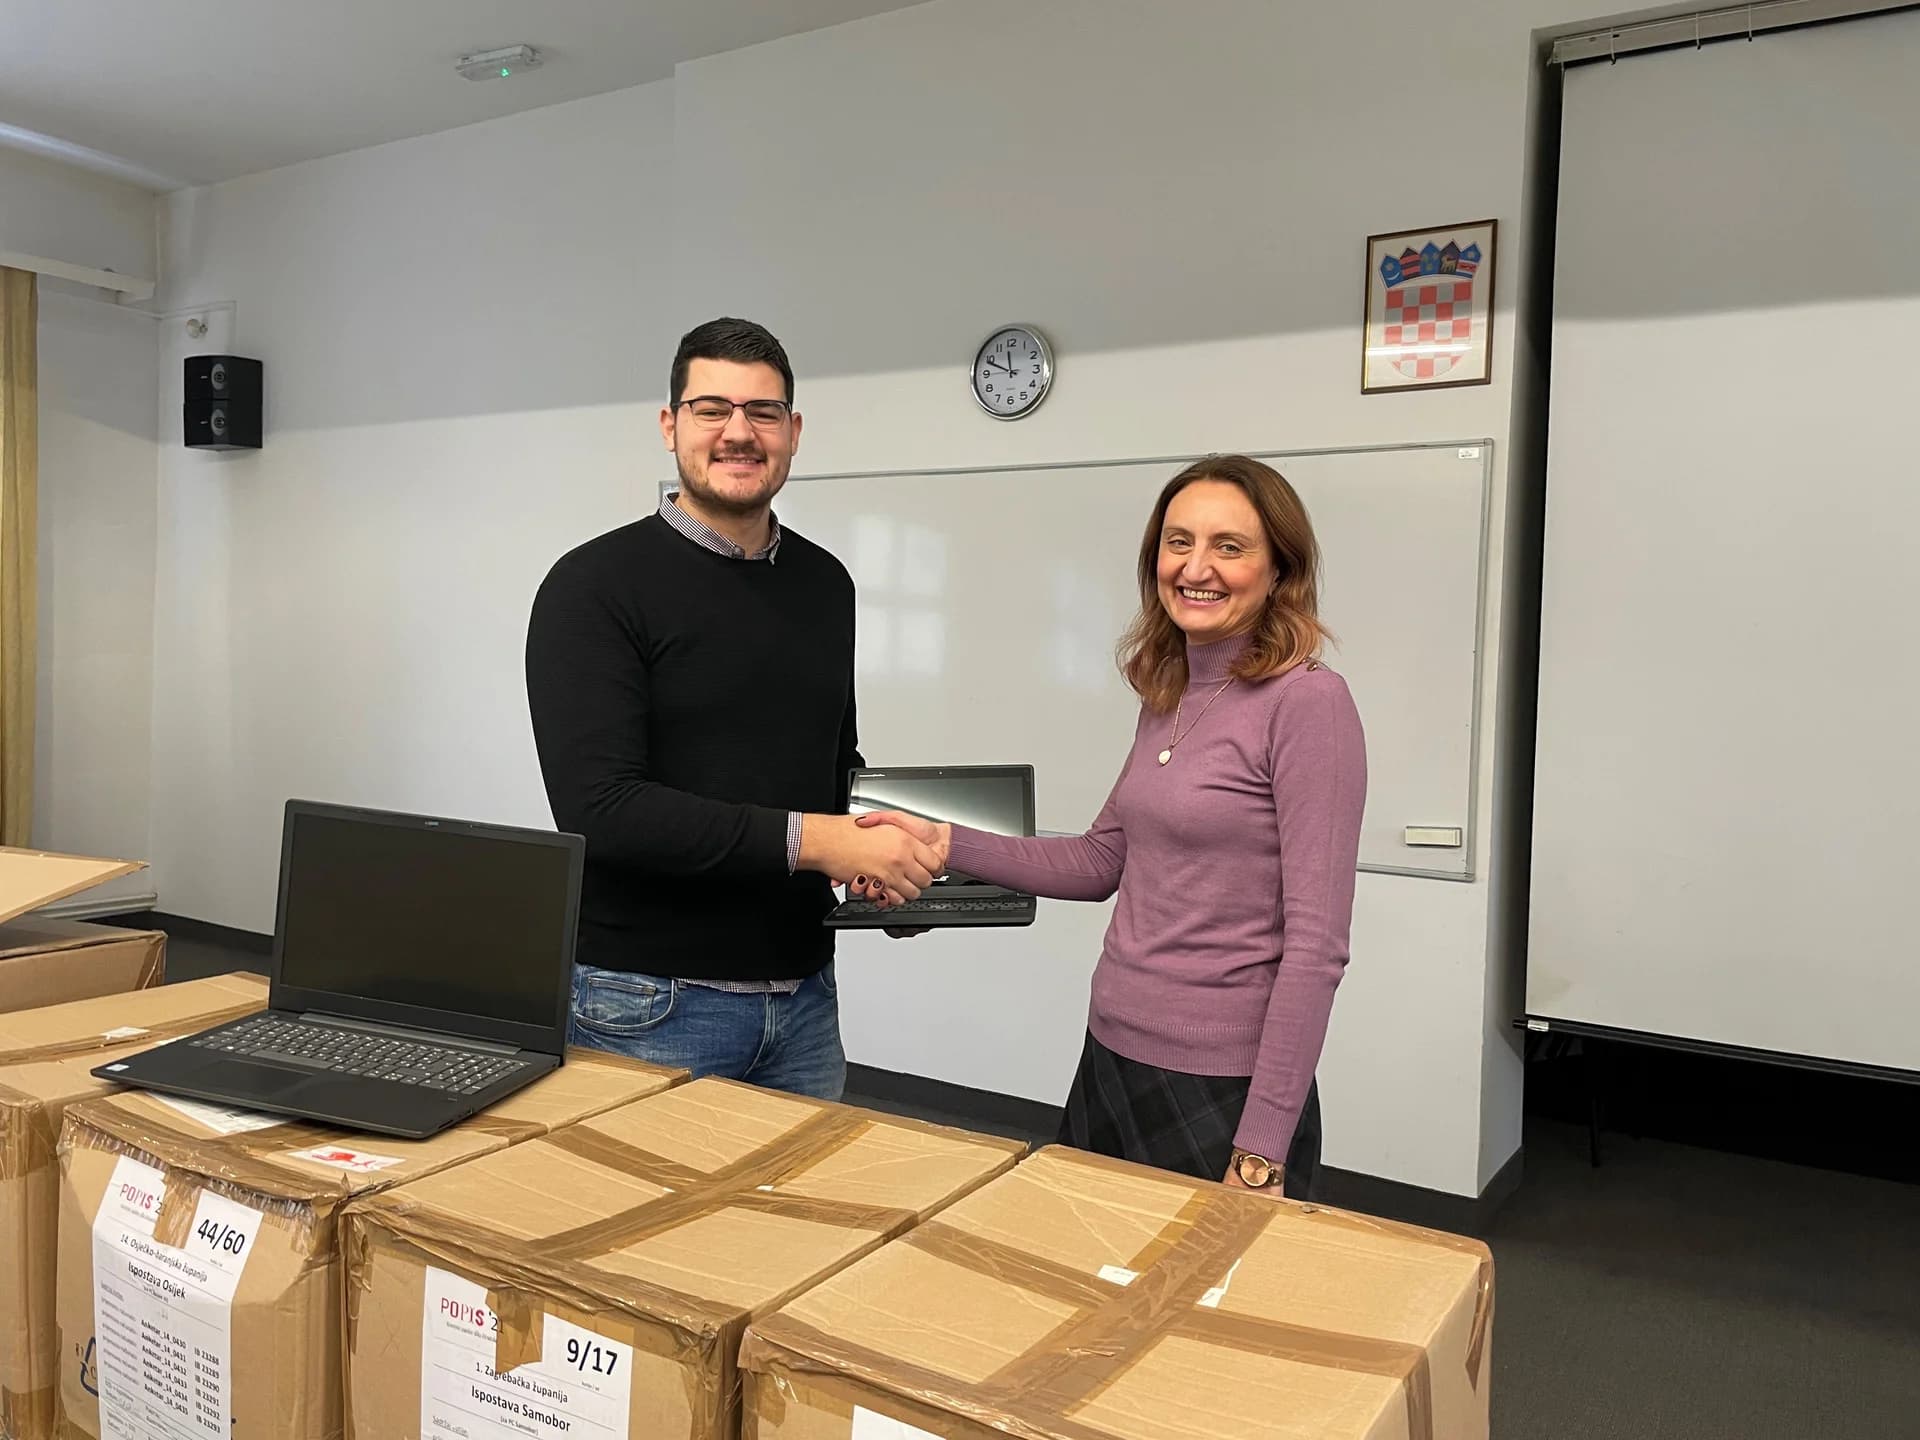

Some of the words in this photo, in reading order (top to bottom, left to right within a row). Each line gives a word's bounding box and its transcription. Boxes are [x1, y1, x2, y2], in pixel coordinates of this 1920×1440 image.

[996, 343, 1002, 352] 11
[1007, 339, 1017, 347] 12
[986, 355, 995, 364] 10
[1030, 351, 1037, 360] 2
[1032, 364, 1040, 374] 3
[983, 370, 990, 378] 9
[1029, 379, 1036, 387] 4
[986, 384, 993, 392] 8
[995, 394, 1001, 403] 7
[1007, 396, 1014, 405] 6
[1020, 392, 1028, 400] 5
[197, 1218, 245, 1255] 44/60
[128, 1261, 161, 1287] Ispostava
[162, 1279, 186, 1299] Osijek
[440, 1297, 484, 1327] POPIS
[567, 1338, 618, 1375] 9/17
[476, 1362, 483, 1373] 1.
[485, 1365, 530, 1390] Zagrebačka
[532, 1382, 568, 1403] županija
[471, 1385, 520, 1413] Ispostava
[522, 1404, 571, 1432] Samobor
